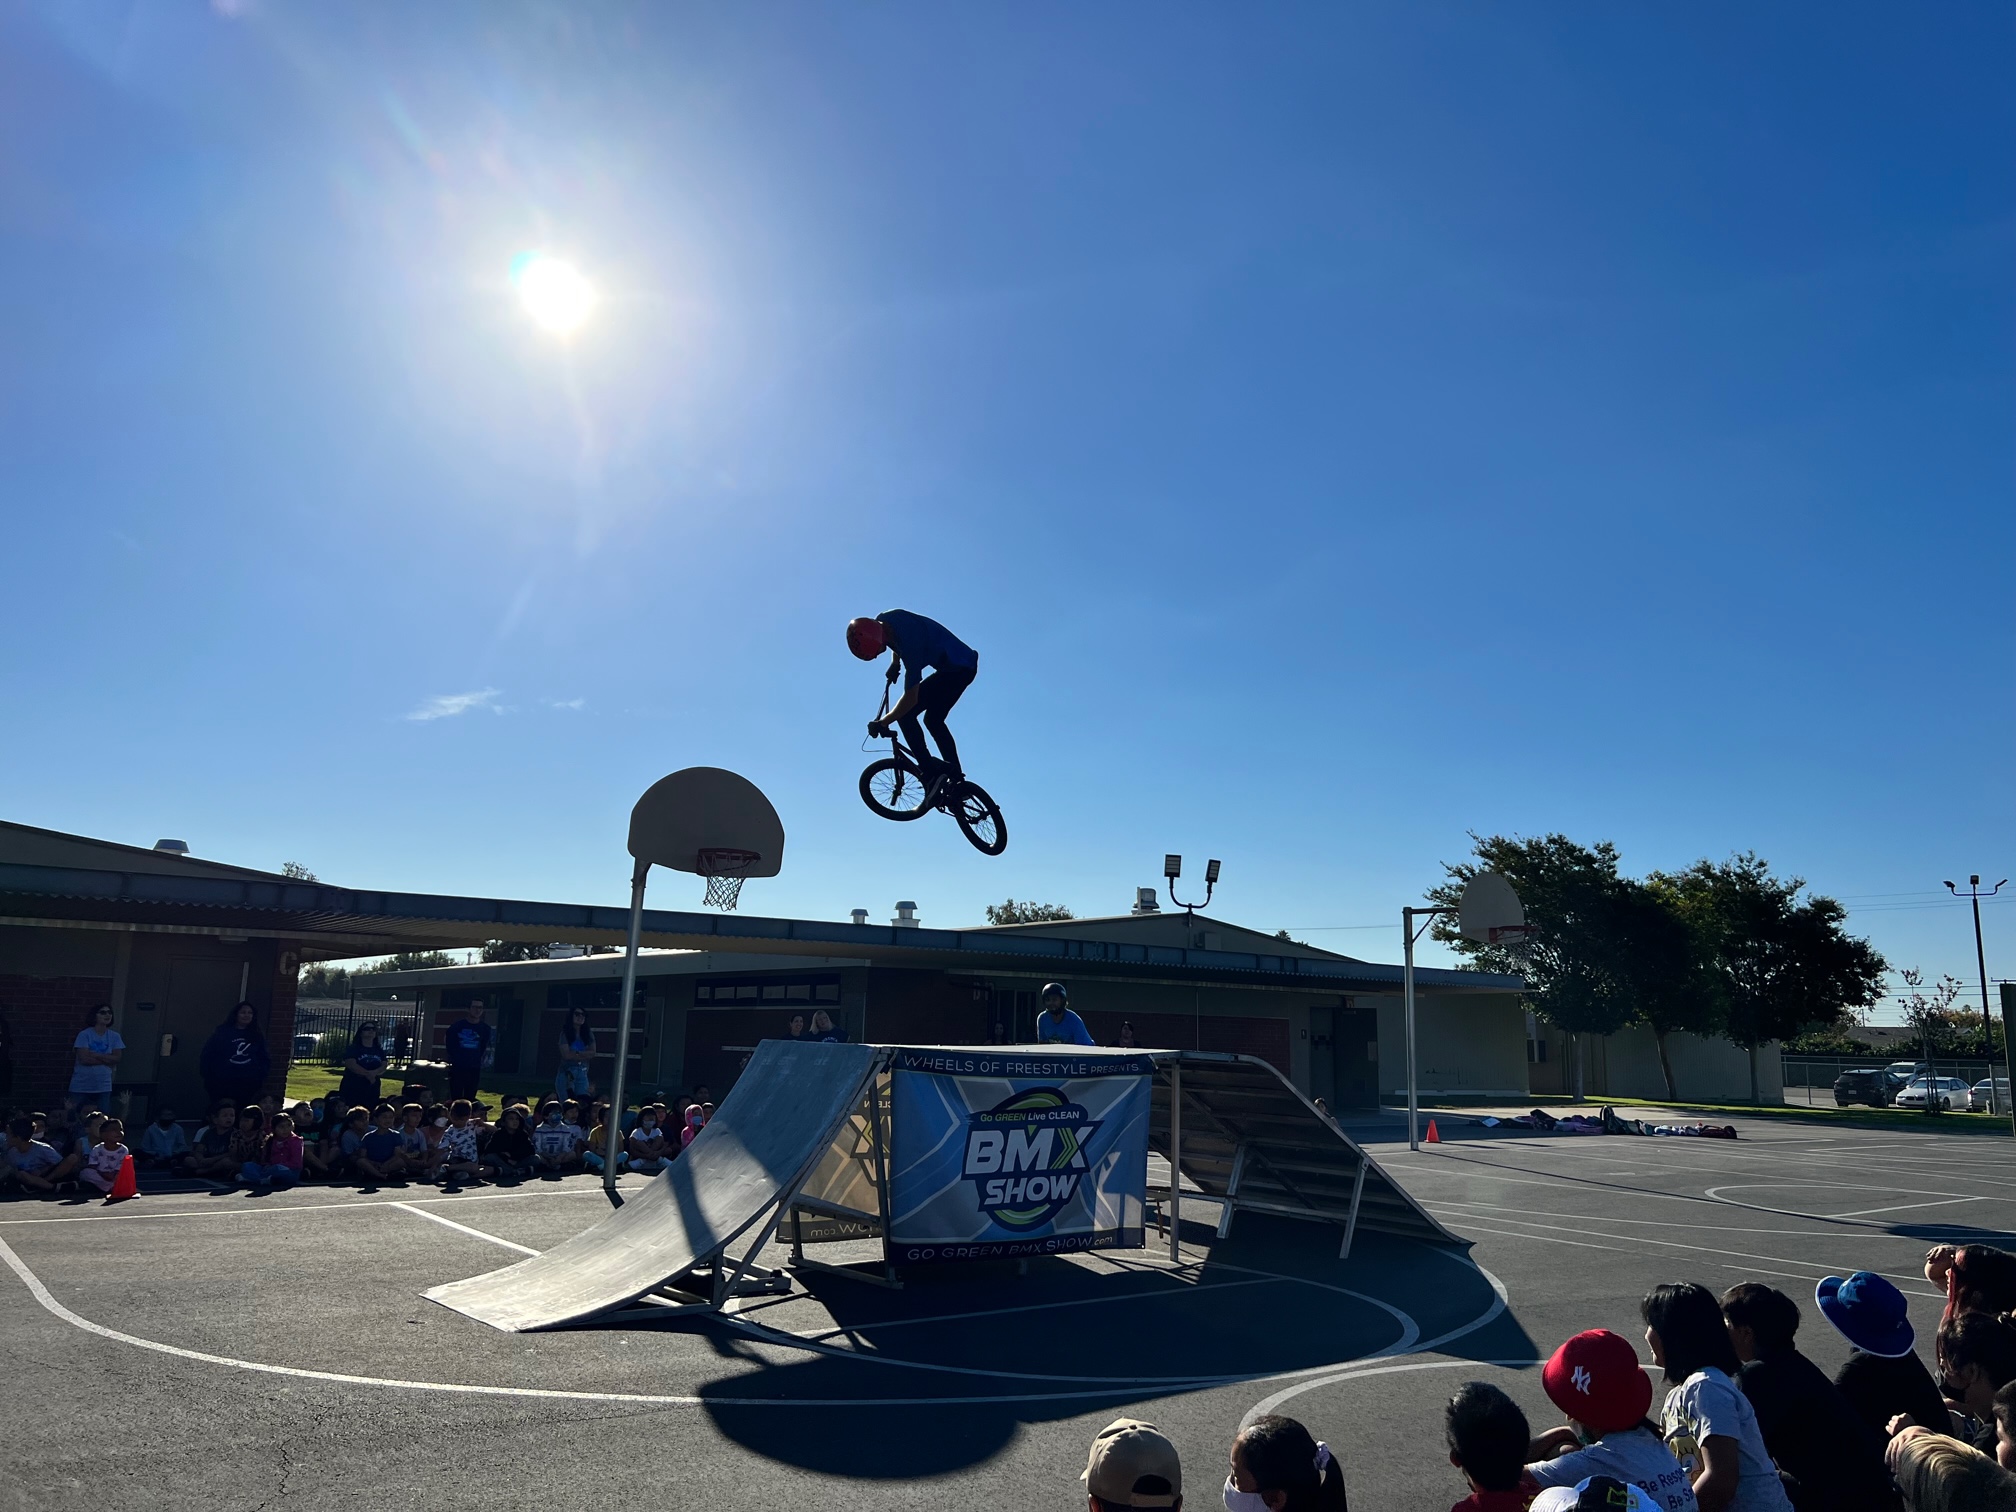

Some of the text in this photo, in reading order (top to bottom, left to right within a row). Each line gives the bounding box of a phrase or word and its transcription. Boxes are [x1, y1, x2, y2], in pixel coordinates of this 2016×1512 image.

[904, 1055, 974, 1072] WHEELS
[980, 1061, 1000, 1073] OF
[1006, 1062, 1087, 1075] FREESTYLE
[980, 1110, 1080, 1122] Go GREEN Live CLEAN
[965, 1125, 1095, 1175] BMX
[983, 1174, 1078, 1205] SHOW
[907, 1235, 1113, 1261] GO GREEN BMX SHOW.com
[1637, 1480, 1658, 1494] Be
[1667, 1495, 1684, 1510] Be
